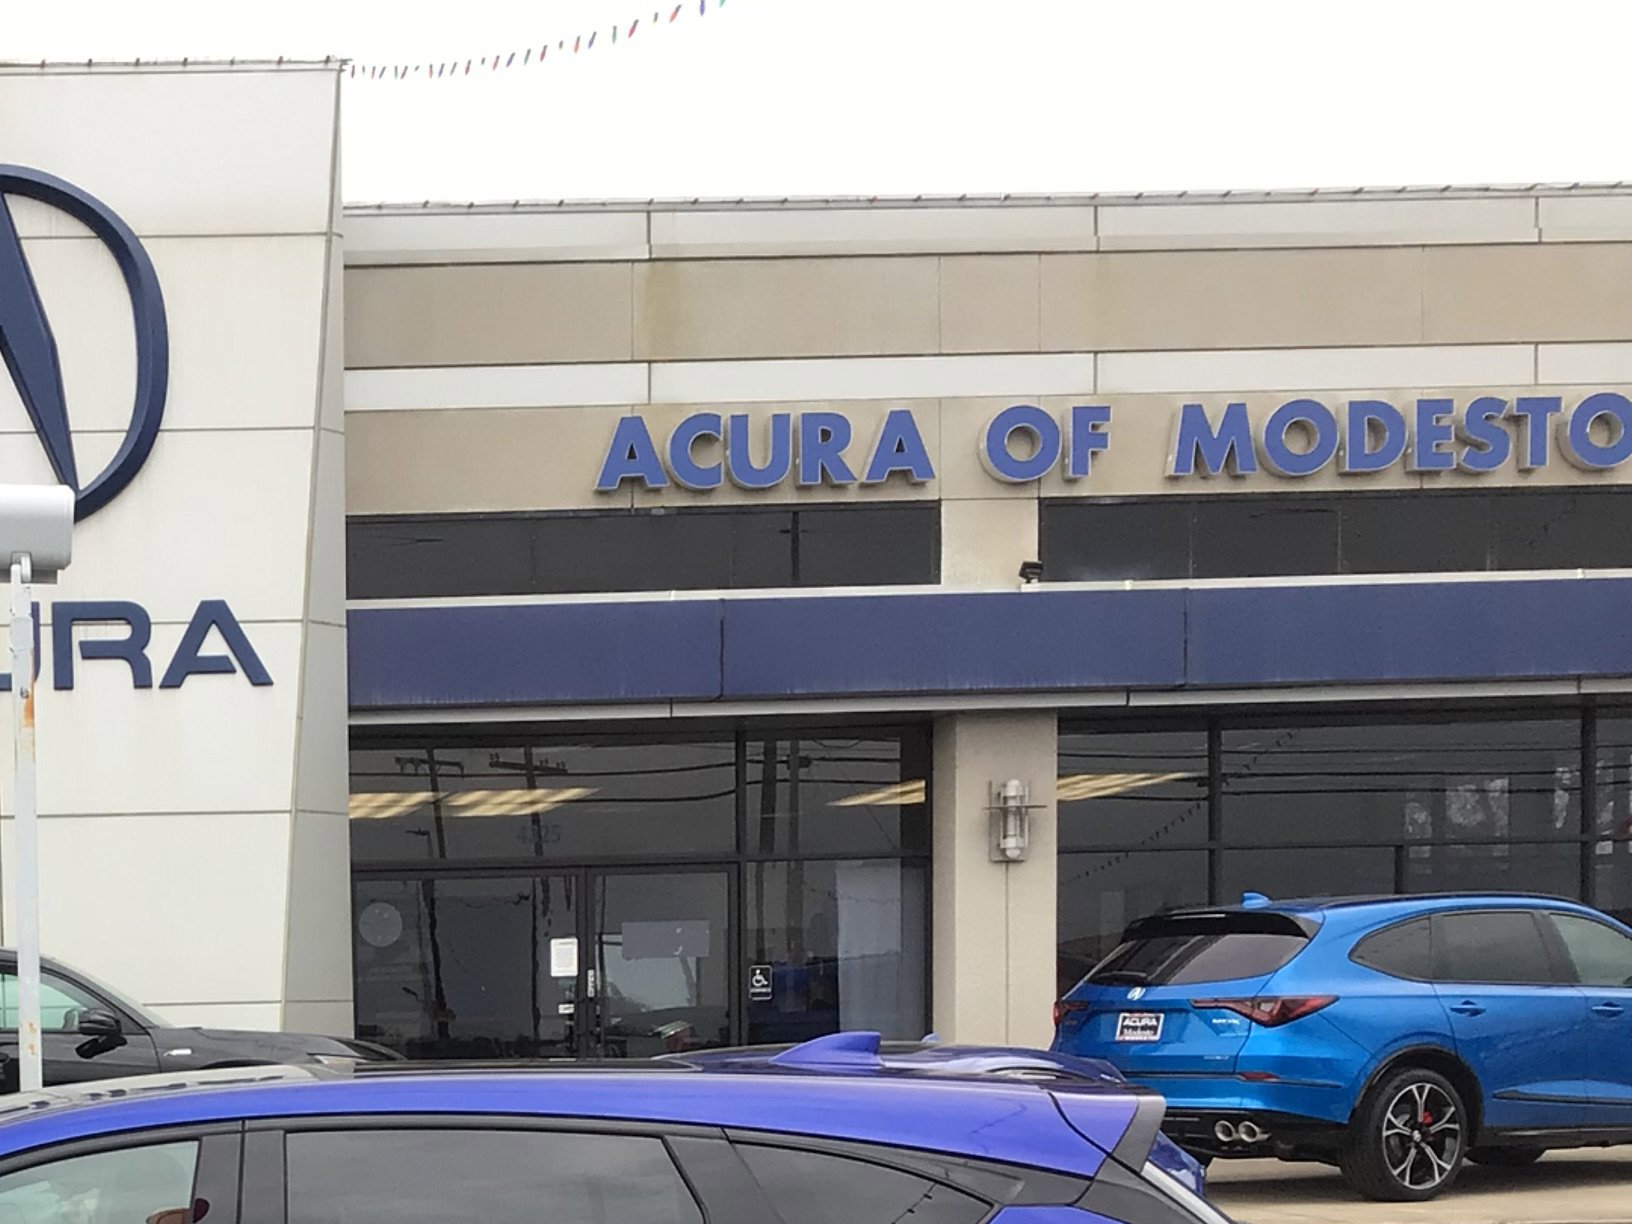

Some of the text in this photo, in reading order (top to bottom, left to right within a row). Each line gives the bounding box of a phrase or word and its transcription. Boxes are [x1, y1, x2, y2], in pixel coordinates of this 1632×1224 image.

[594, 392, 1632, 491] ACURA OF MODESTO
[1123, 1017, 1158, 1026] ACURA
